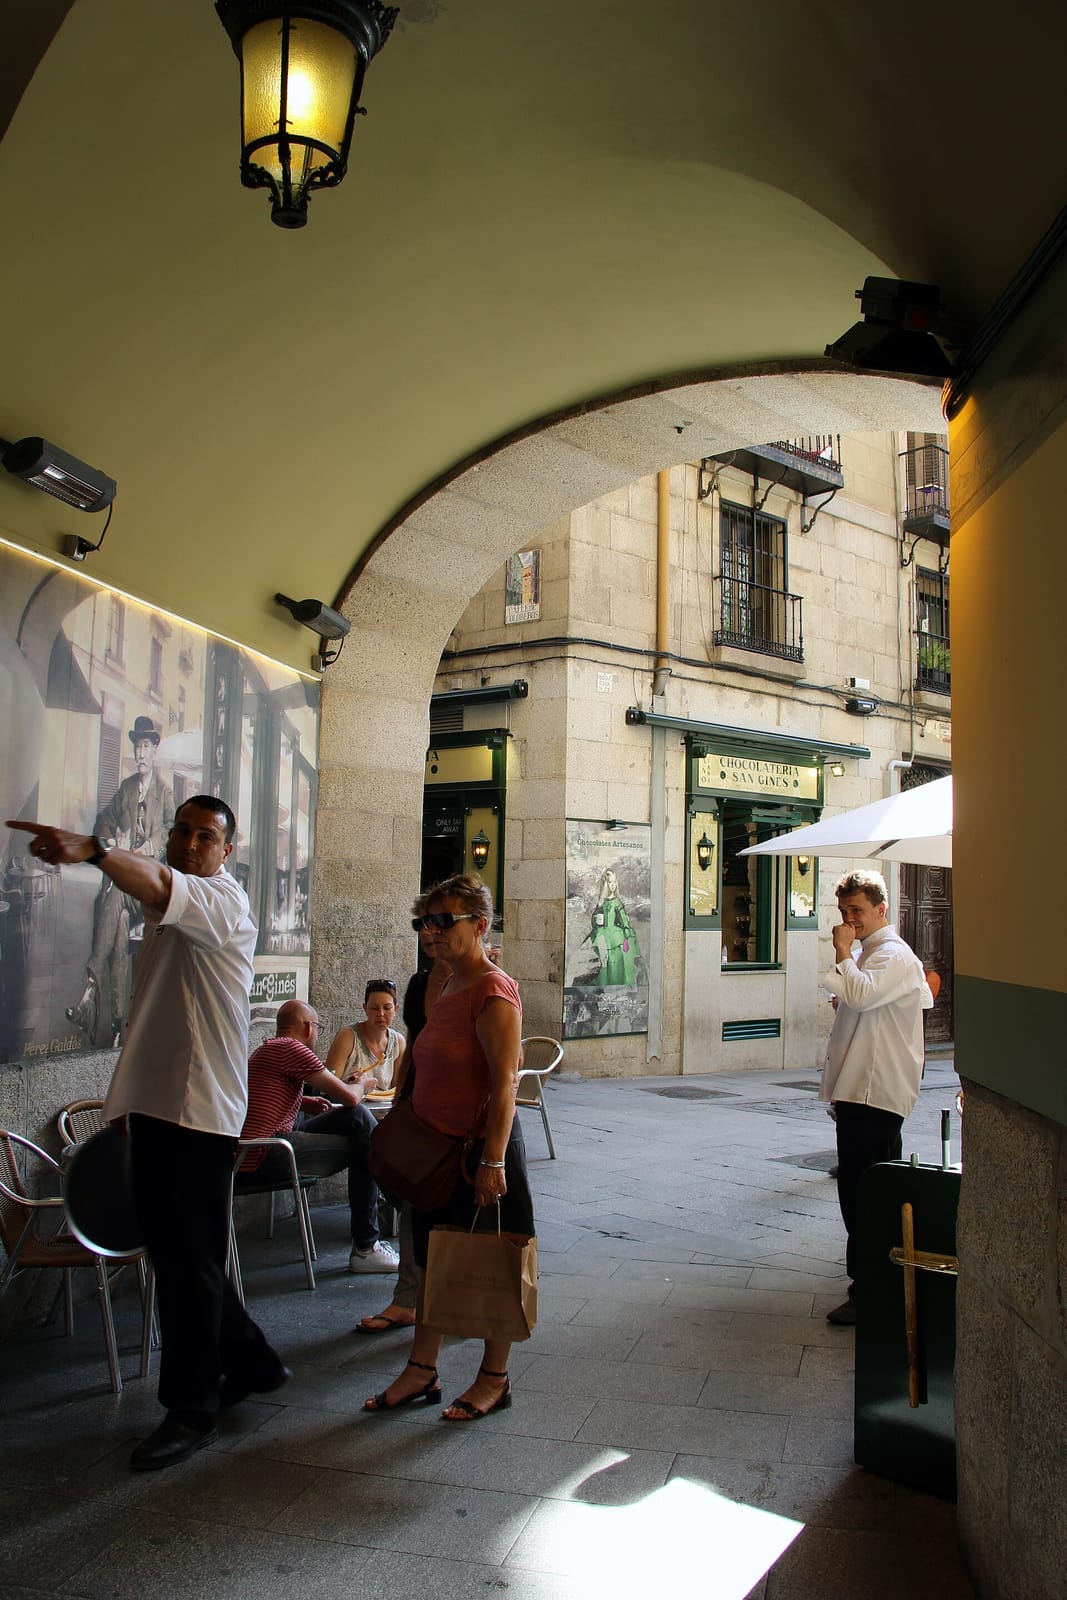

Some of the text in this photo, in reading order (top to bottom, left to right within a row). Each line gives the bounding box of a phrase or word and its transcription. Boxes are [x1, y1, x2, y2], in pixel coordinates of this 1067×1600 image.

[719, 757, 799, 776] CHOCOLATERIA
[732, 771, 754, 783] SAN
[758, 774, 788, 787] GINES
[577, 838, 611, 847] Chocolates
